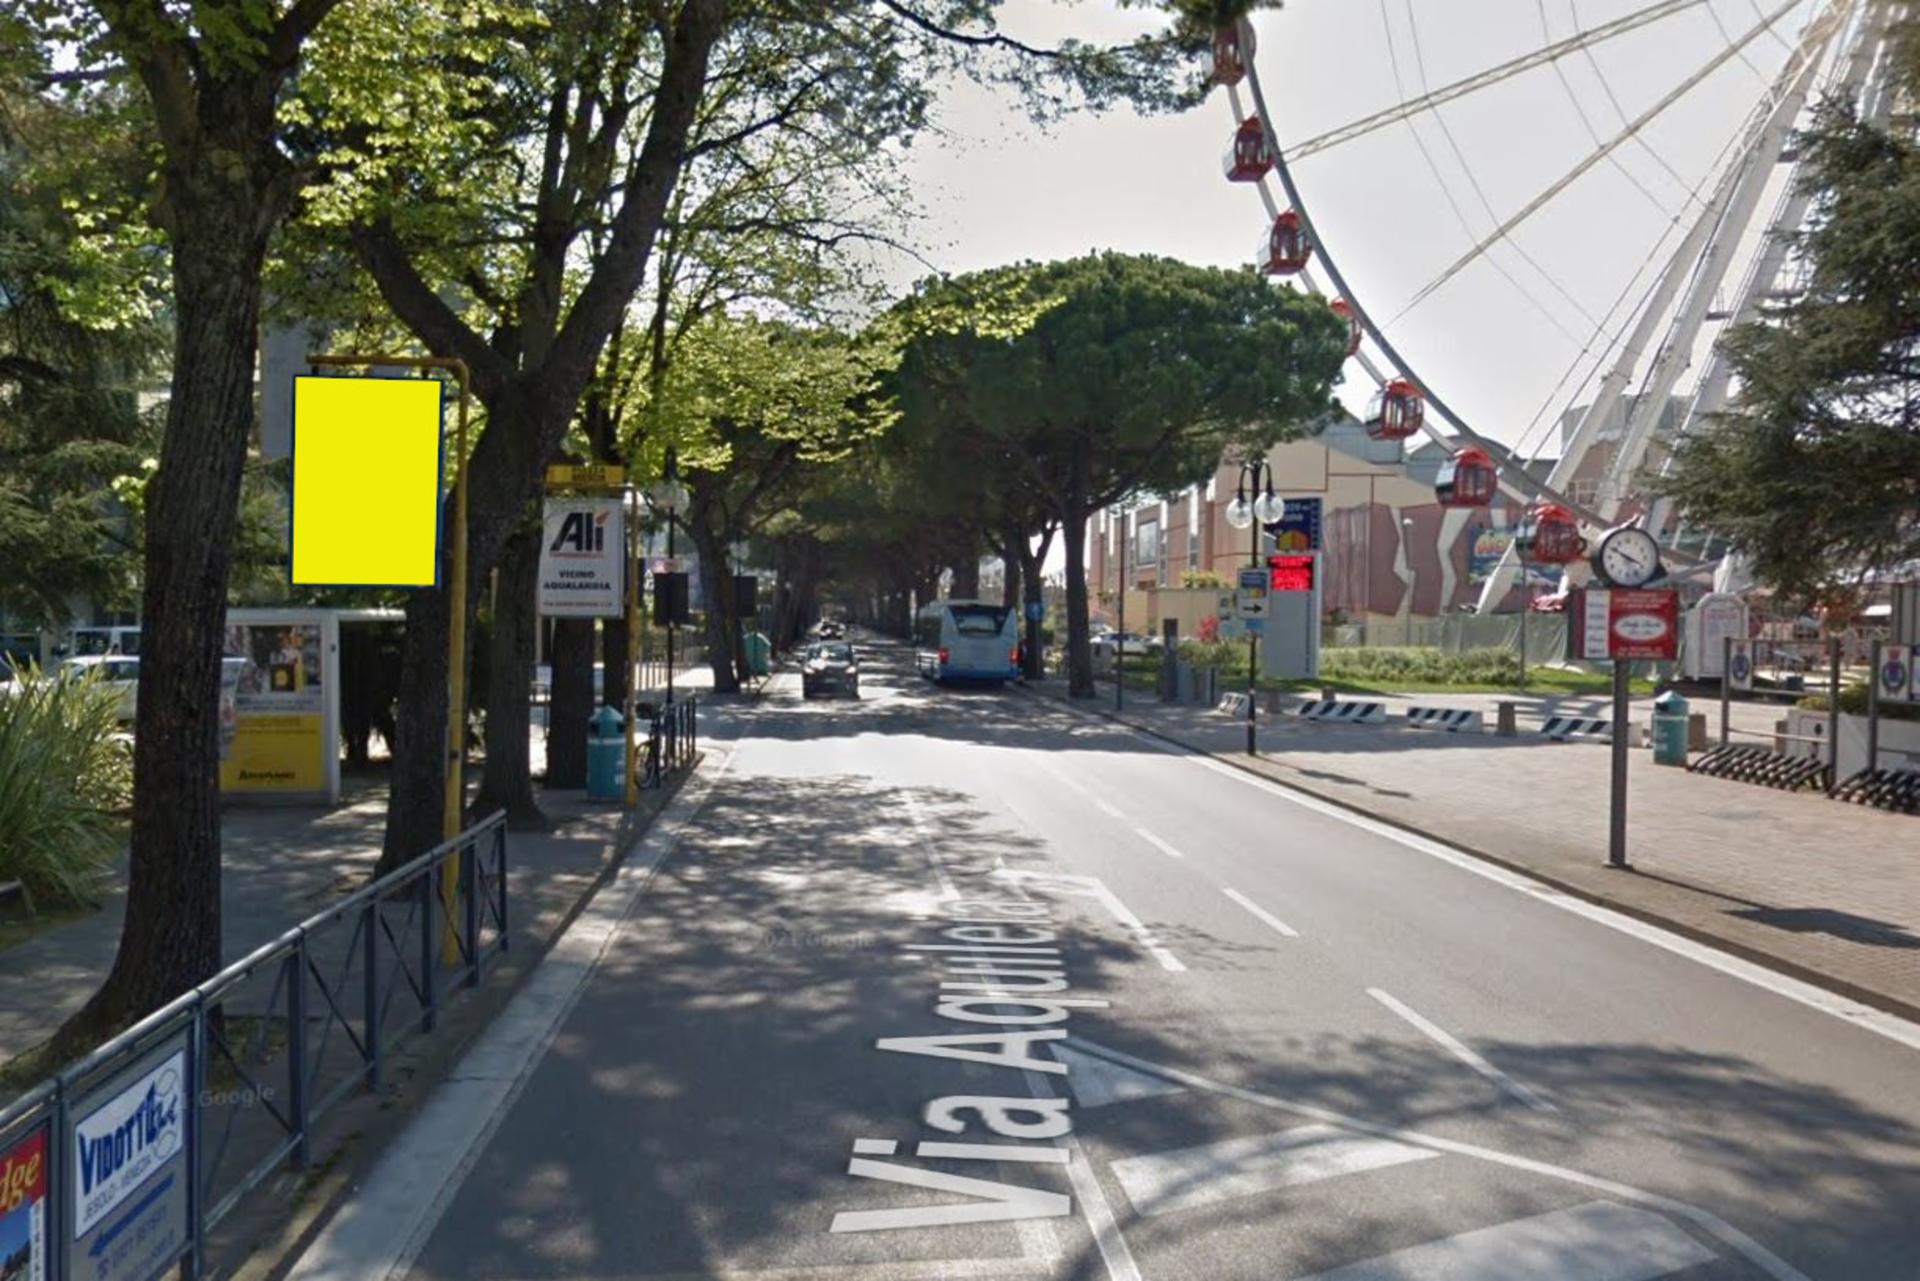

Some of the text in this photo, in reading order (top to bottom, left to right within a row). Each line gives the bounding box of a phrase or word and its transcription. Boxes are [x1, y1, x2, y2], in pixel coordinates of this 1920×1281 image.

[558, 570, 595, 579] VICINO
[543, 581, 612, 591] AQUALANDIA
[829, 899, 1110, 1233] Via Aquileia
